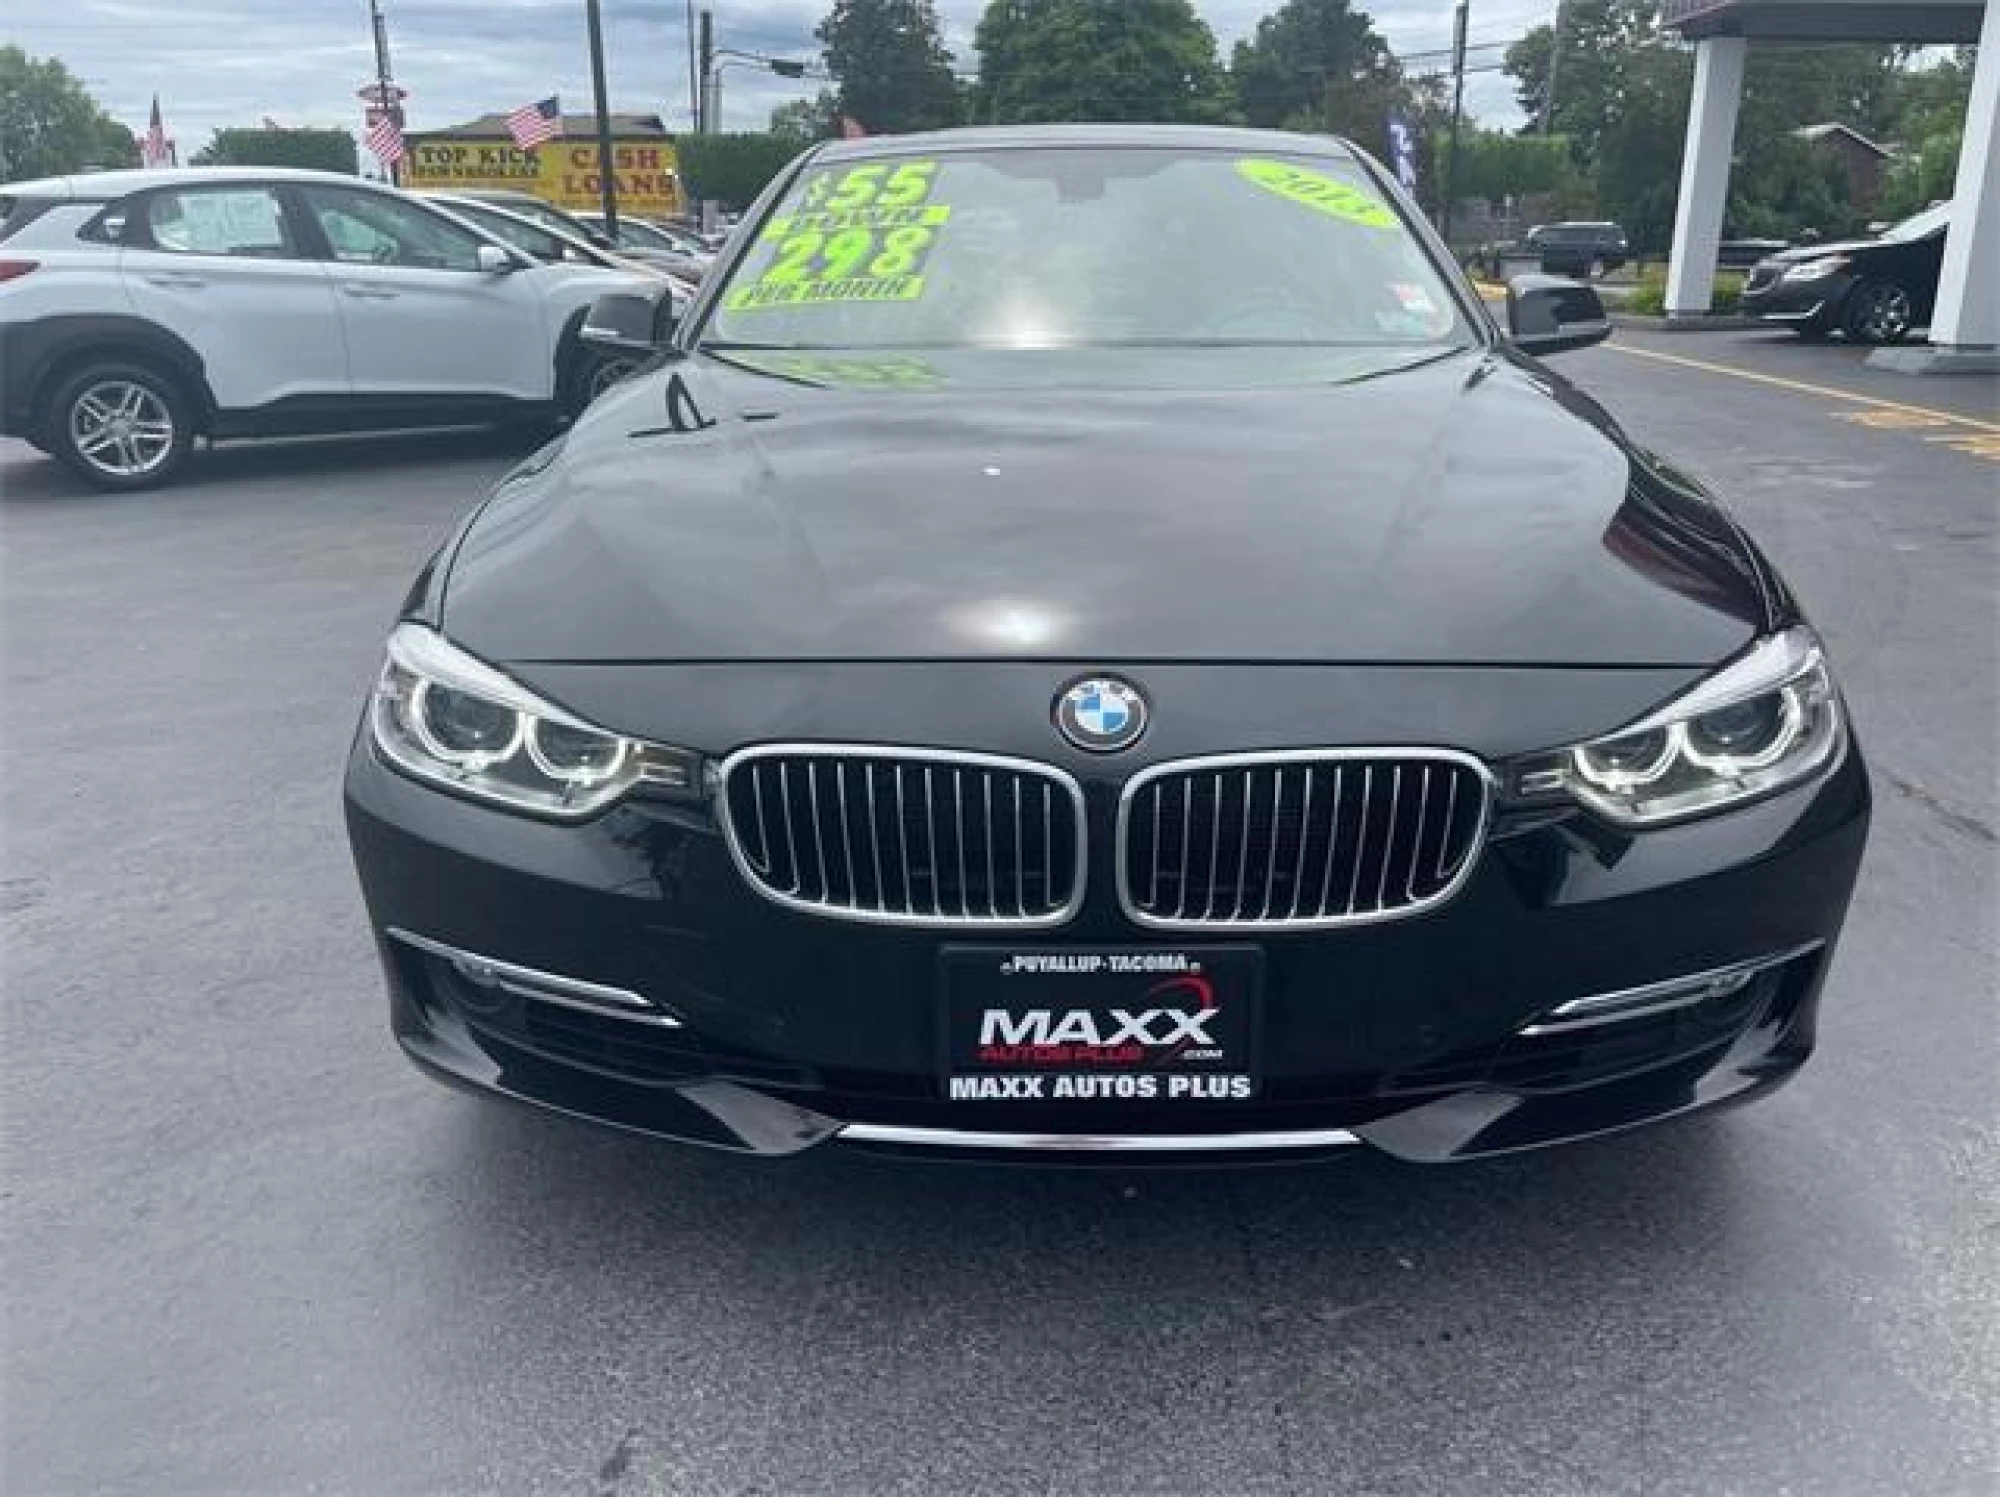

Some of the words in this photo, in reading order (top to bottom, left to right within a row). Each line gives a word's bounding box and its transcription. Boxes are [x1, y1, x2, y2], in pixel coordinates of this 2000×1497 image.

[421, 146, 467, 164] TOP
[479, 146, 541, 164] KICK
[570, 148, 660, 169] CSH
[762, 225, 931, 283] 298
[979, 1008, 1221, 1046] MAXX
[949, 1074, 1044, 1100] MAXX
[1052, 1074, 1158, 1099] AUTOS
[1168, 1074, 1251, 1099] PLUS
